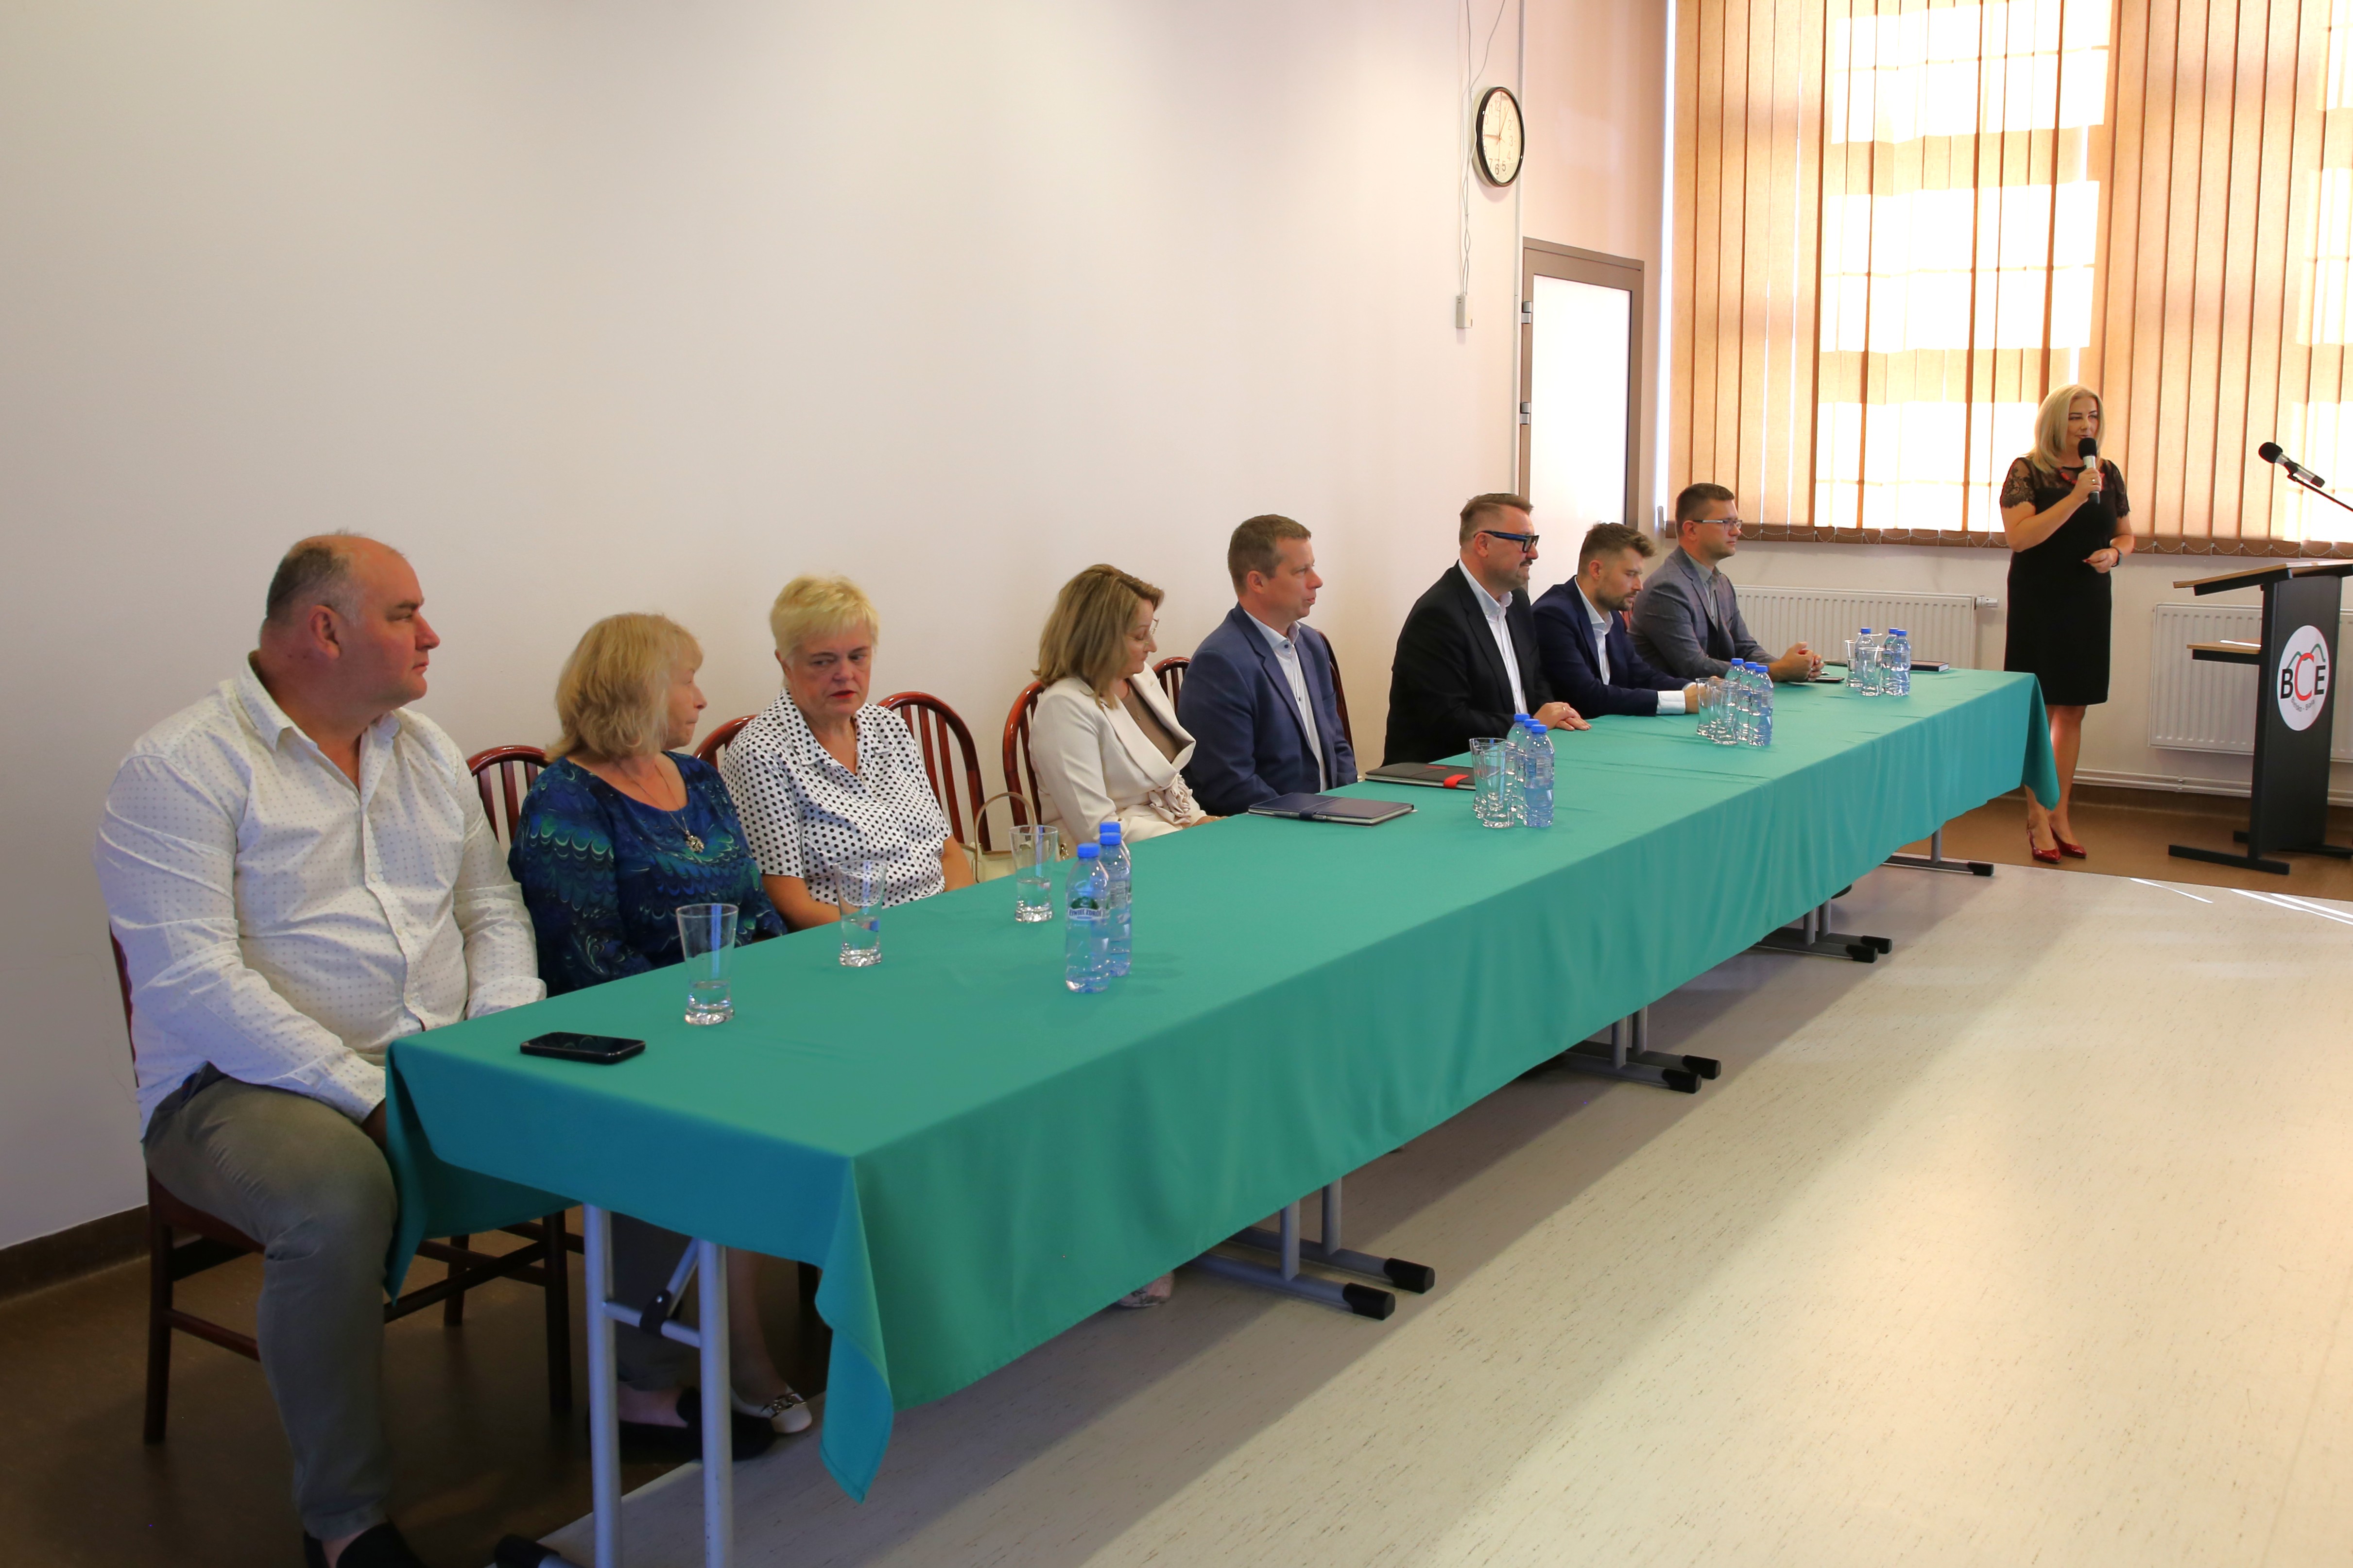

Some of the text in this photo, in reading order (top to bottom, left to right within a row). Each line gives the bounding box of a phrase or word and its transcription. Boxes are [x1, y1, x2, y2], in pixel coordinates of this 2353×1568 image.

[1488, 103, 1493, 115] 11
[1508, 119, 1512, 131] 2
[1509, 136, 1513, 147] 3
[1507, 150, 1511, 162] 4
[1488, 158, 1493, 170] 7
[1495, 164, 1500, 175] 6
[1502, 160, 1506, 172] 5
[2281, 652, 2326, 701] BCE
